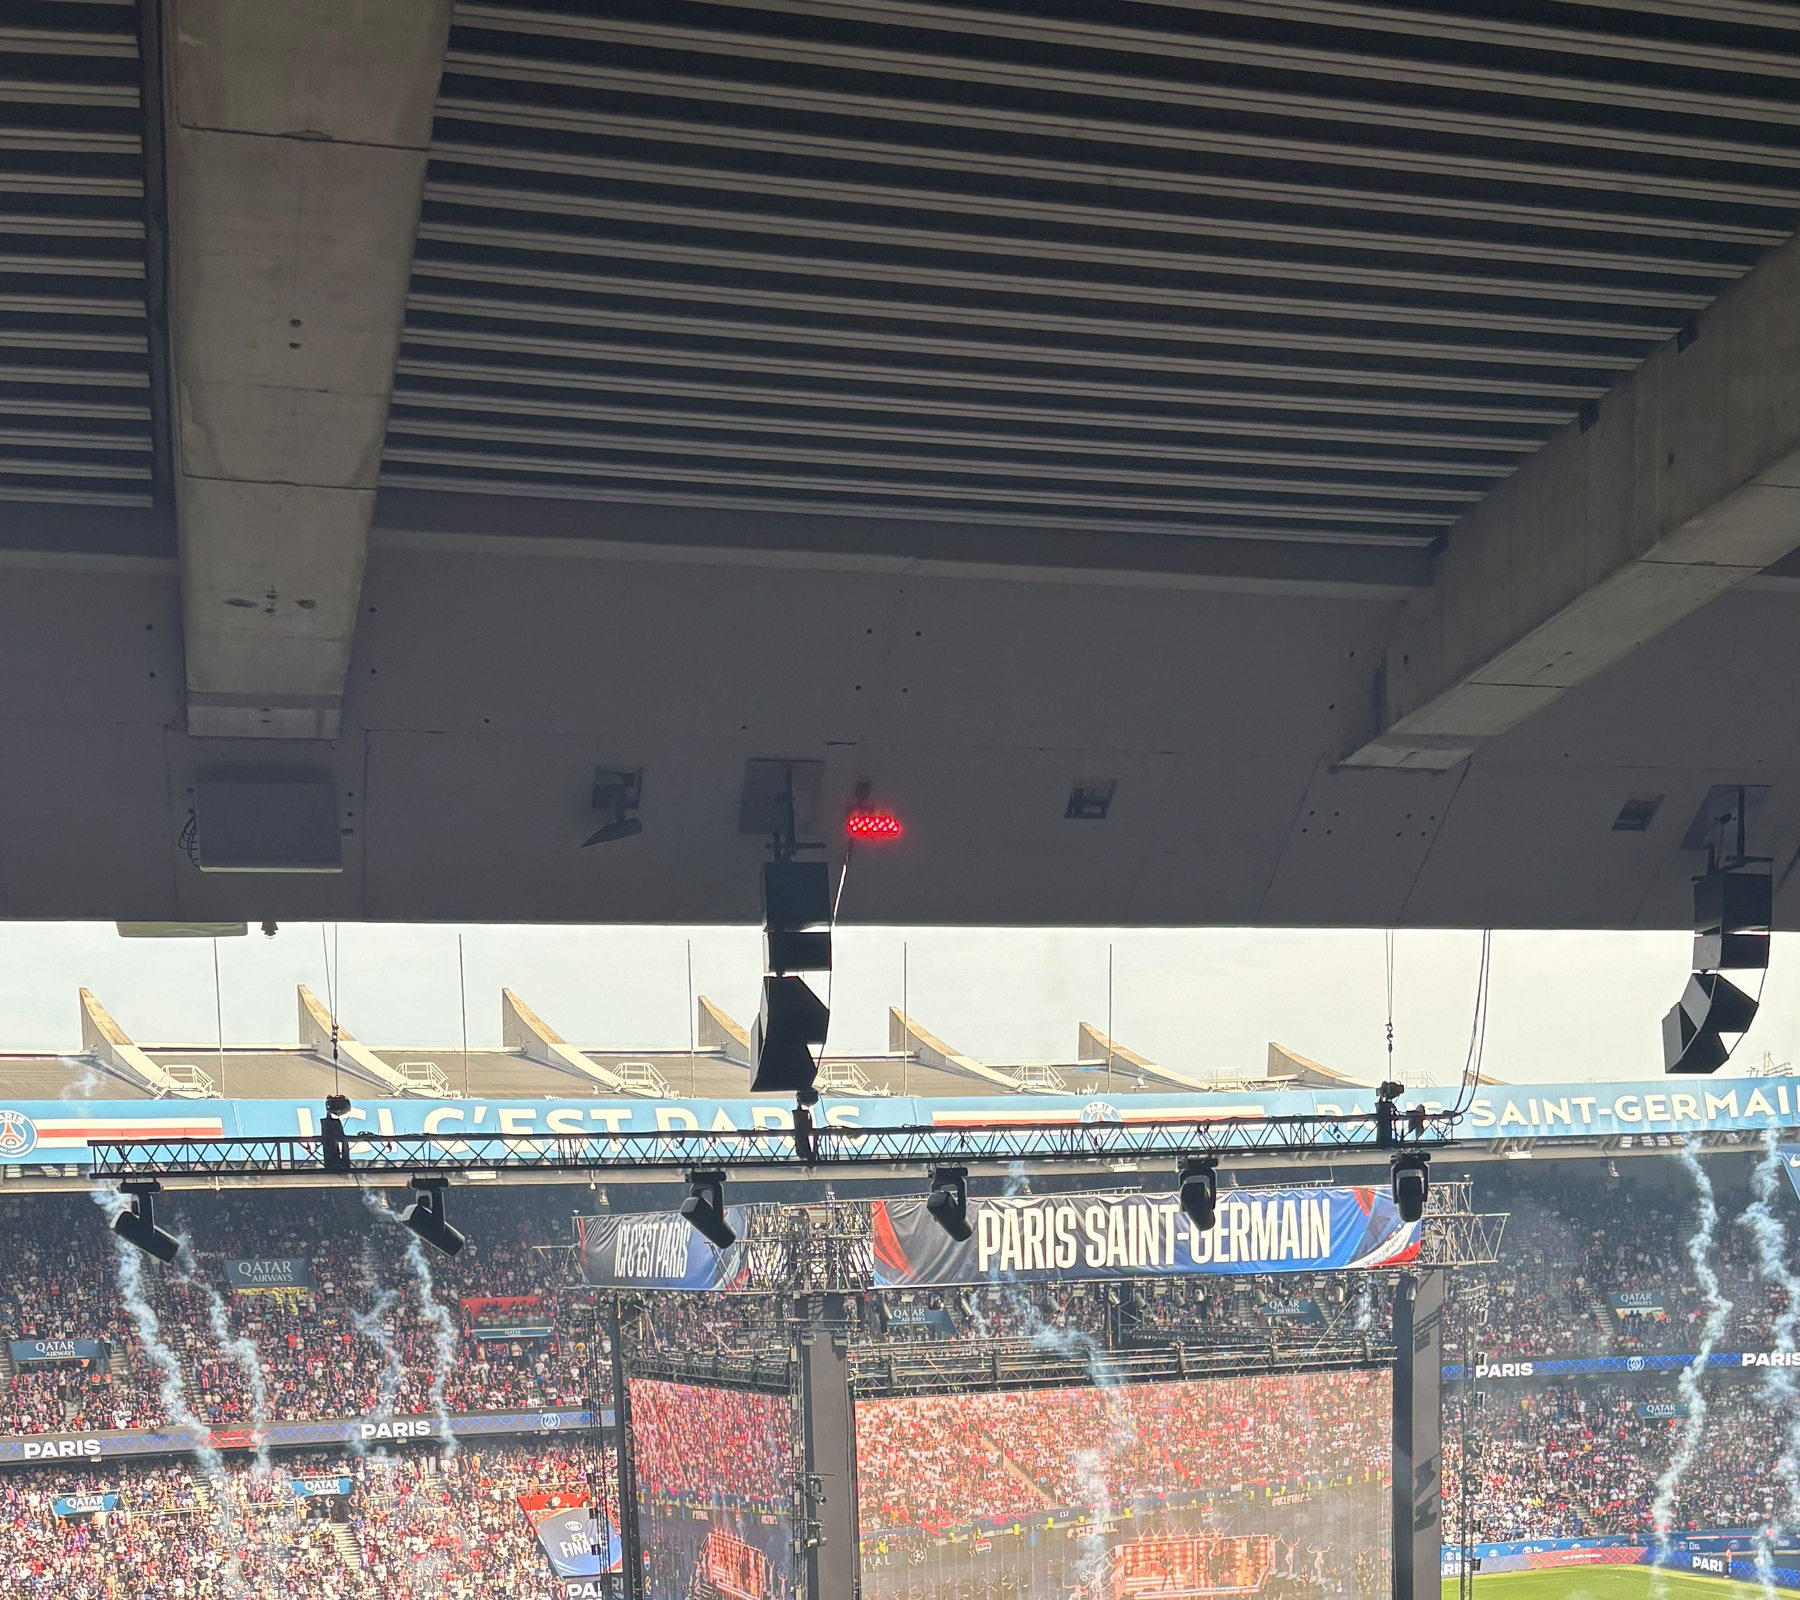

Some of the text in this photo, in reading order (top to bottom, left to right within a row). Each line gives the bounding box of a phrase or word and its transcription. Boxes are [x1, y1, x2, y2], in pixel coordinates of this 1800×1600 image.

[1470, 1085, 1800, 1127] SAINT-GERMAI
[424, 1106, 633, 1154] C'EST
[977, 1198, 1331, 1272] PARIS SAINT-GERMAIN
[614, 1220, 691, 1279] ICI C'EST PARIS
[238, 1261, 292, 1277] QATAR
[251, 1273, 294, 1283] AIRWAYS
[1269, 1299, 1300, 1310] QAAR
[1620, 1293, 1652, 1303] QATAR
[893, 1308, 925, 1319] QAAR
[35, 1340, 75, 1354] QATAR
[45, 1350, 76, 1358] AIRWAYS
[1475, 1362, 1534, 1379] PARIS
[1646, 1404, 1676, 1414] QATAR
[360, 1420, 431, 1439] PARIS
[23, 1439, 101, 1459] PARIS
[304, 1479, 340, 1492] QATAR
[66, 1496, 104, 1509] QATAR
[570, 1531, 587, 1542] EN
[1692, 1556, 1723, 1572] PARI
